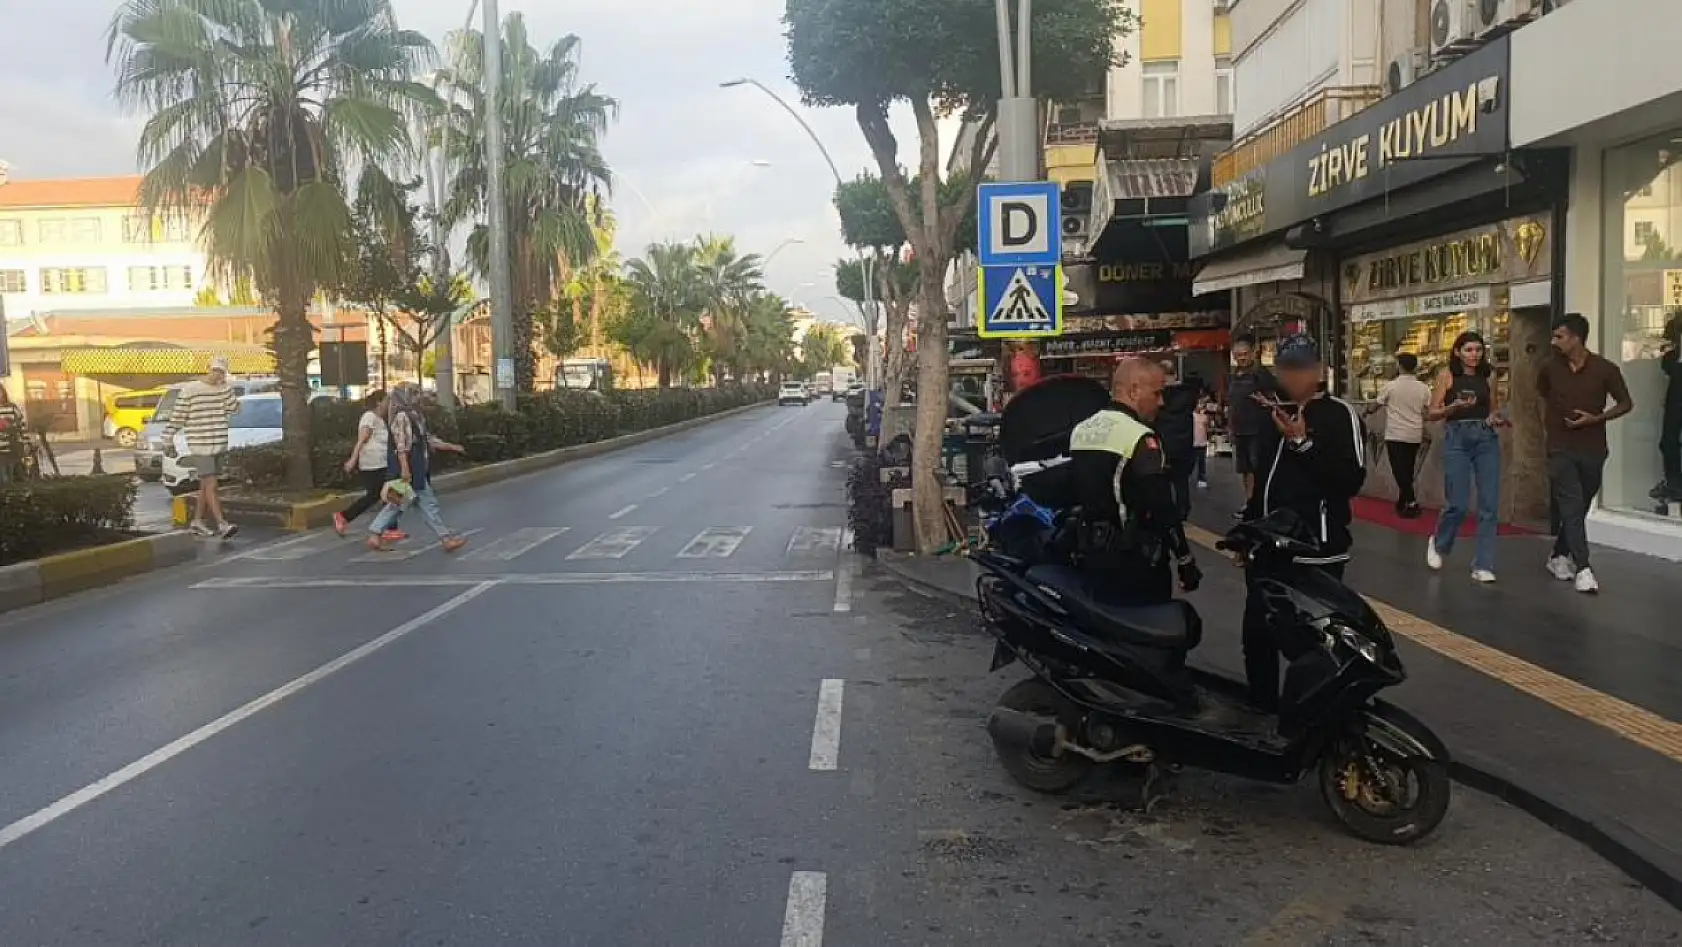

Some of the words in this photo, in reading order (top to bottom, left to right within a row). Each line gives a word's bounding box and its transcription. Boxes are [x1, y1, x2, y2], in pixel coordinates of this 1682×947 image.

[1308, 134, 1370, 197] ZİRVE
[1378, 82, 1477, 168] KUYUM
[1001, 202, 1037, 246] D
[1100, 261, 1163, 282] DÖNER
[1369, 250, 1422, 290] ZİRVE
[1425, 231, 1500, 282] KUYUM
